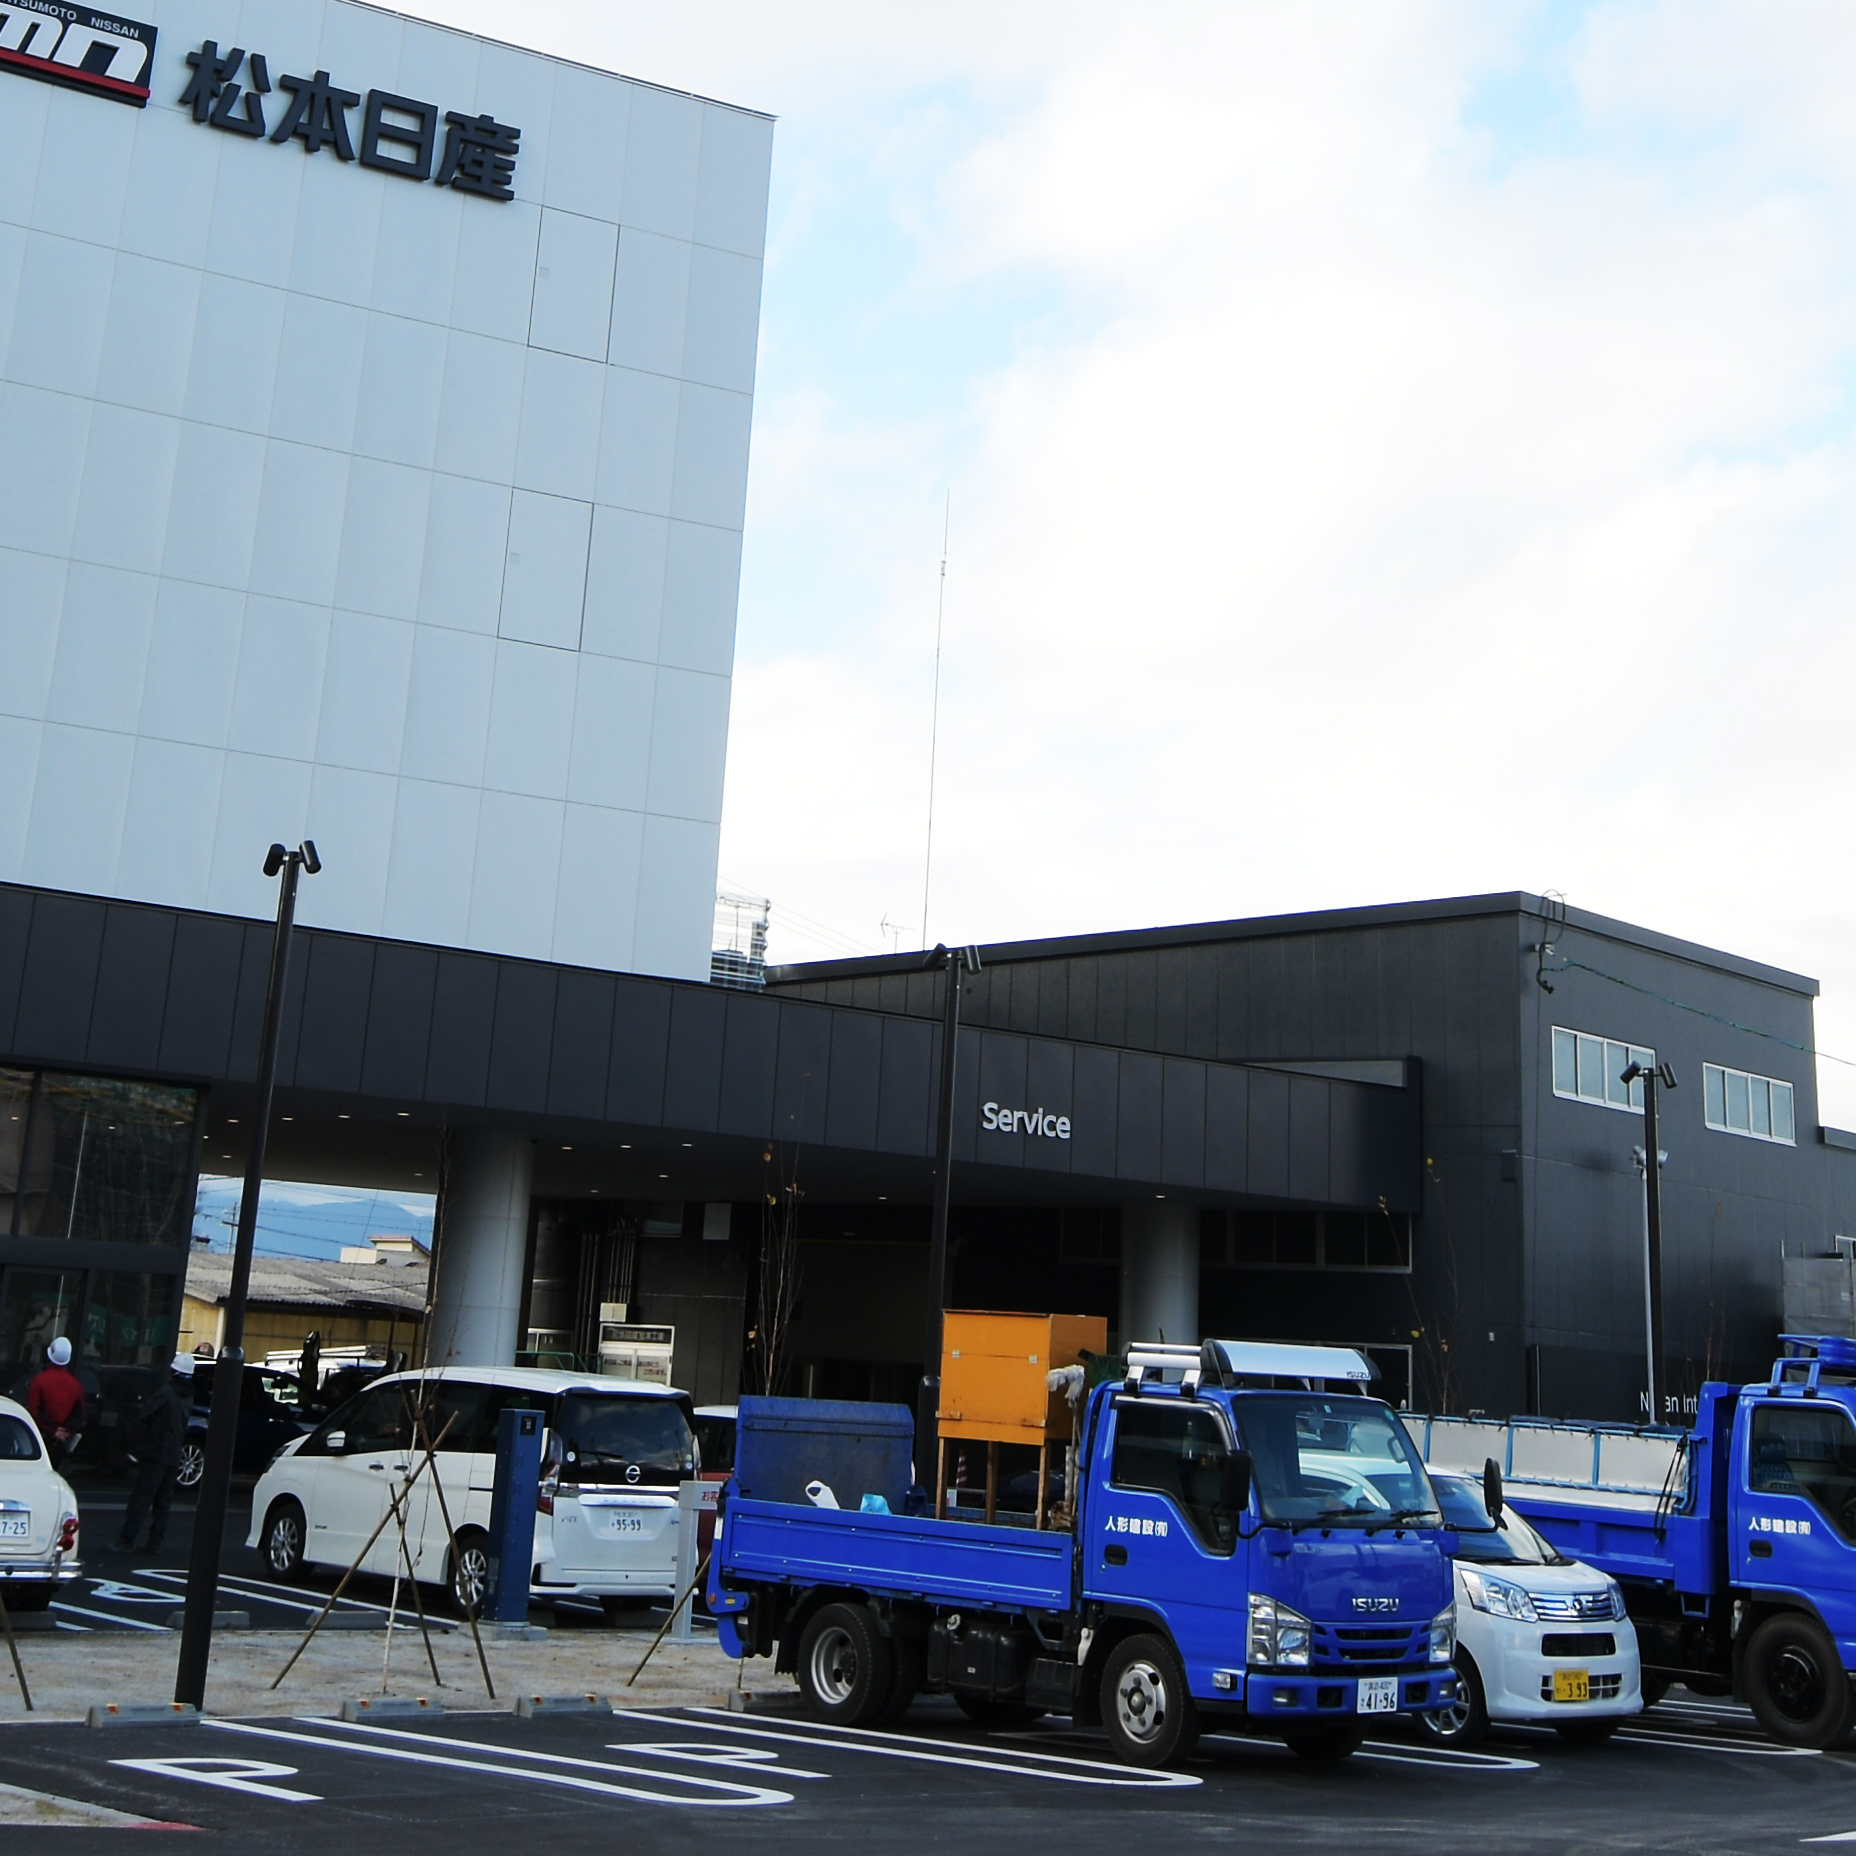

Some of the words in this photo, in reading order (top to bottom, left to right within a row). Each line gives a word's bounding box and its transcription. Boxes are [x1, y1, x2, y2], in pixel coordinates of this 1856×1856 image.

[90, 16, 139, 39] NISSAN
[178, 39, 521, 202] 松本日産
[982, 1101, 1071, 1139] Service
[1640, 1391, 1679, 1413] Nan
[1351, 1598, 1400, 1612] ISUZU
